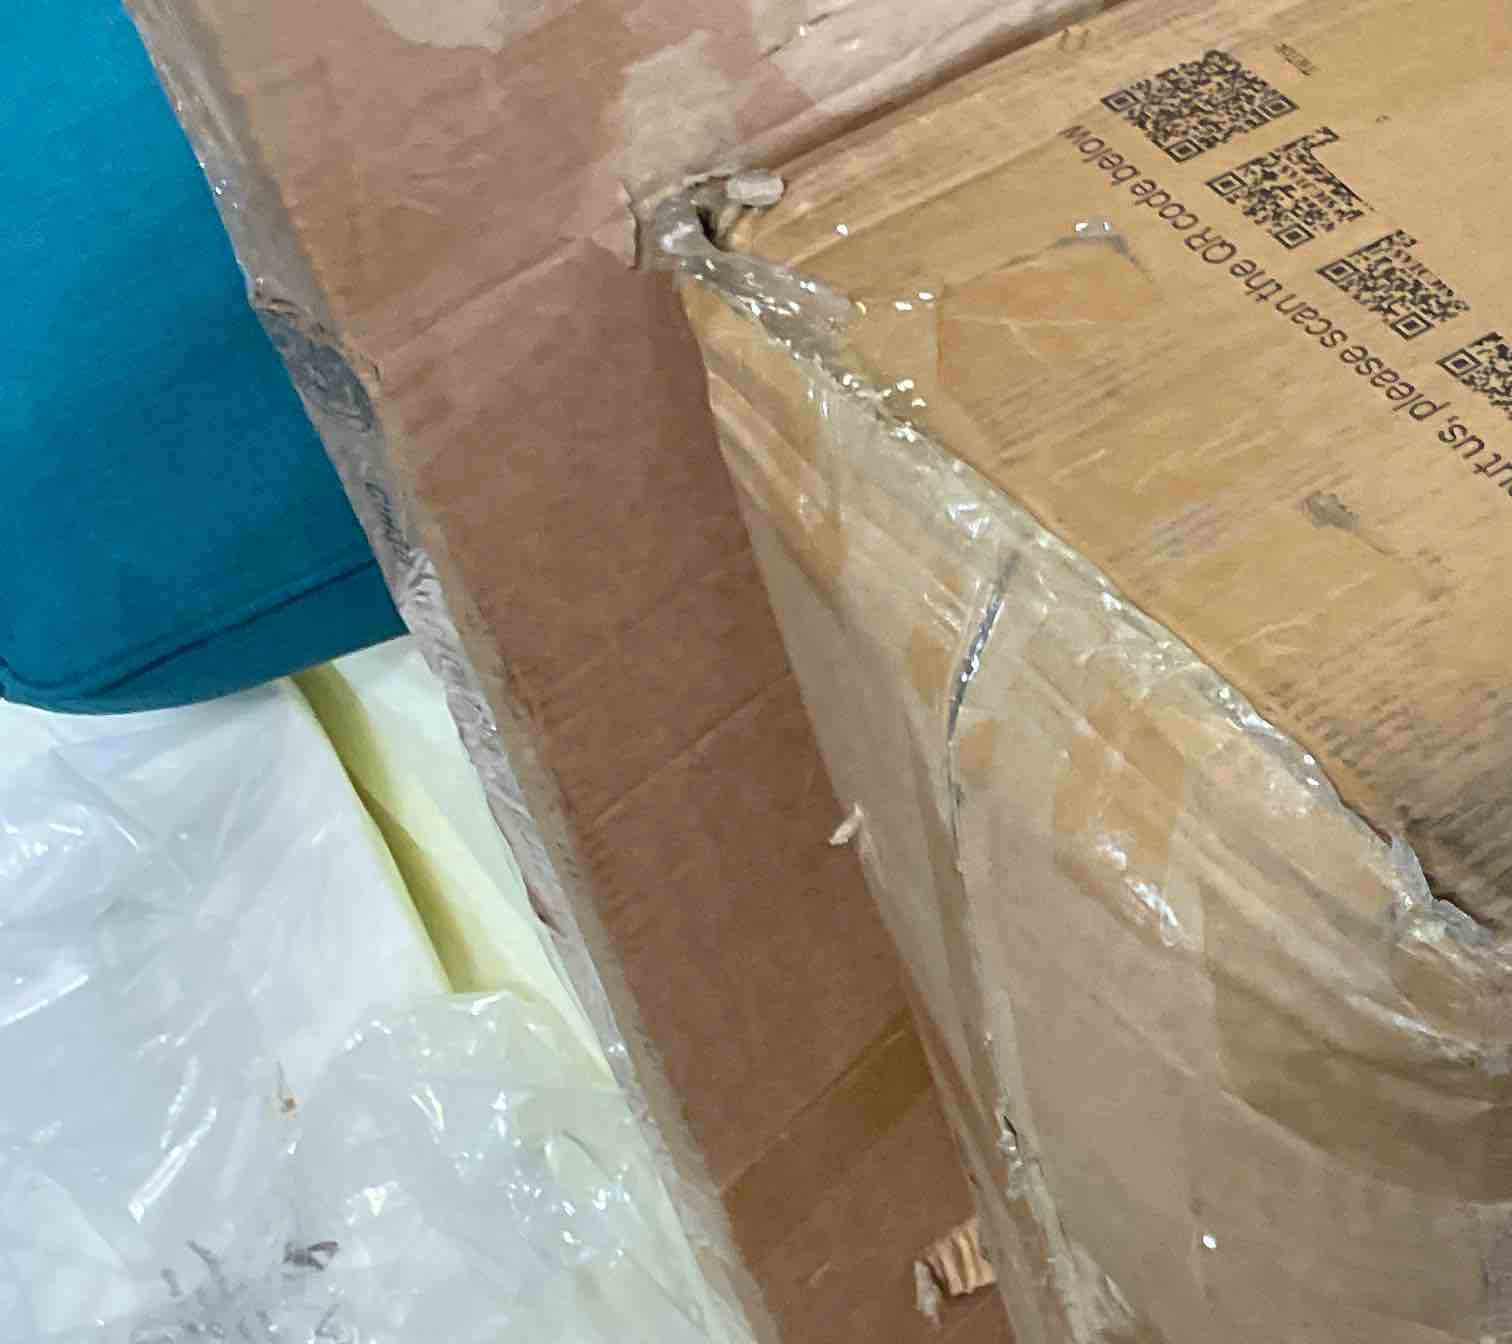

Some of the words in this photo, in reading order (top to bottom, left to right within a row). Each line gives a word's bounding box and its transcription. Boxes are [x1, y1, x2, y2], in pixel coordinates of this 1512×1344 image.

[1058, 124, 1141, 186] below
[1129, 179, 1199, 231] code
[1184, 226, 1237, 264] QR
[1229, 259, 1283, 302] the
[1276, 293, 1348, 349] scan
[1339, 344, 1451, 422] please
[1437, 416, 1486, 459] us,
